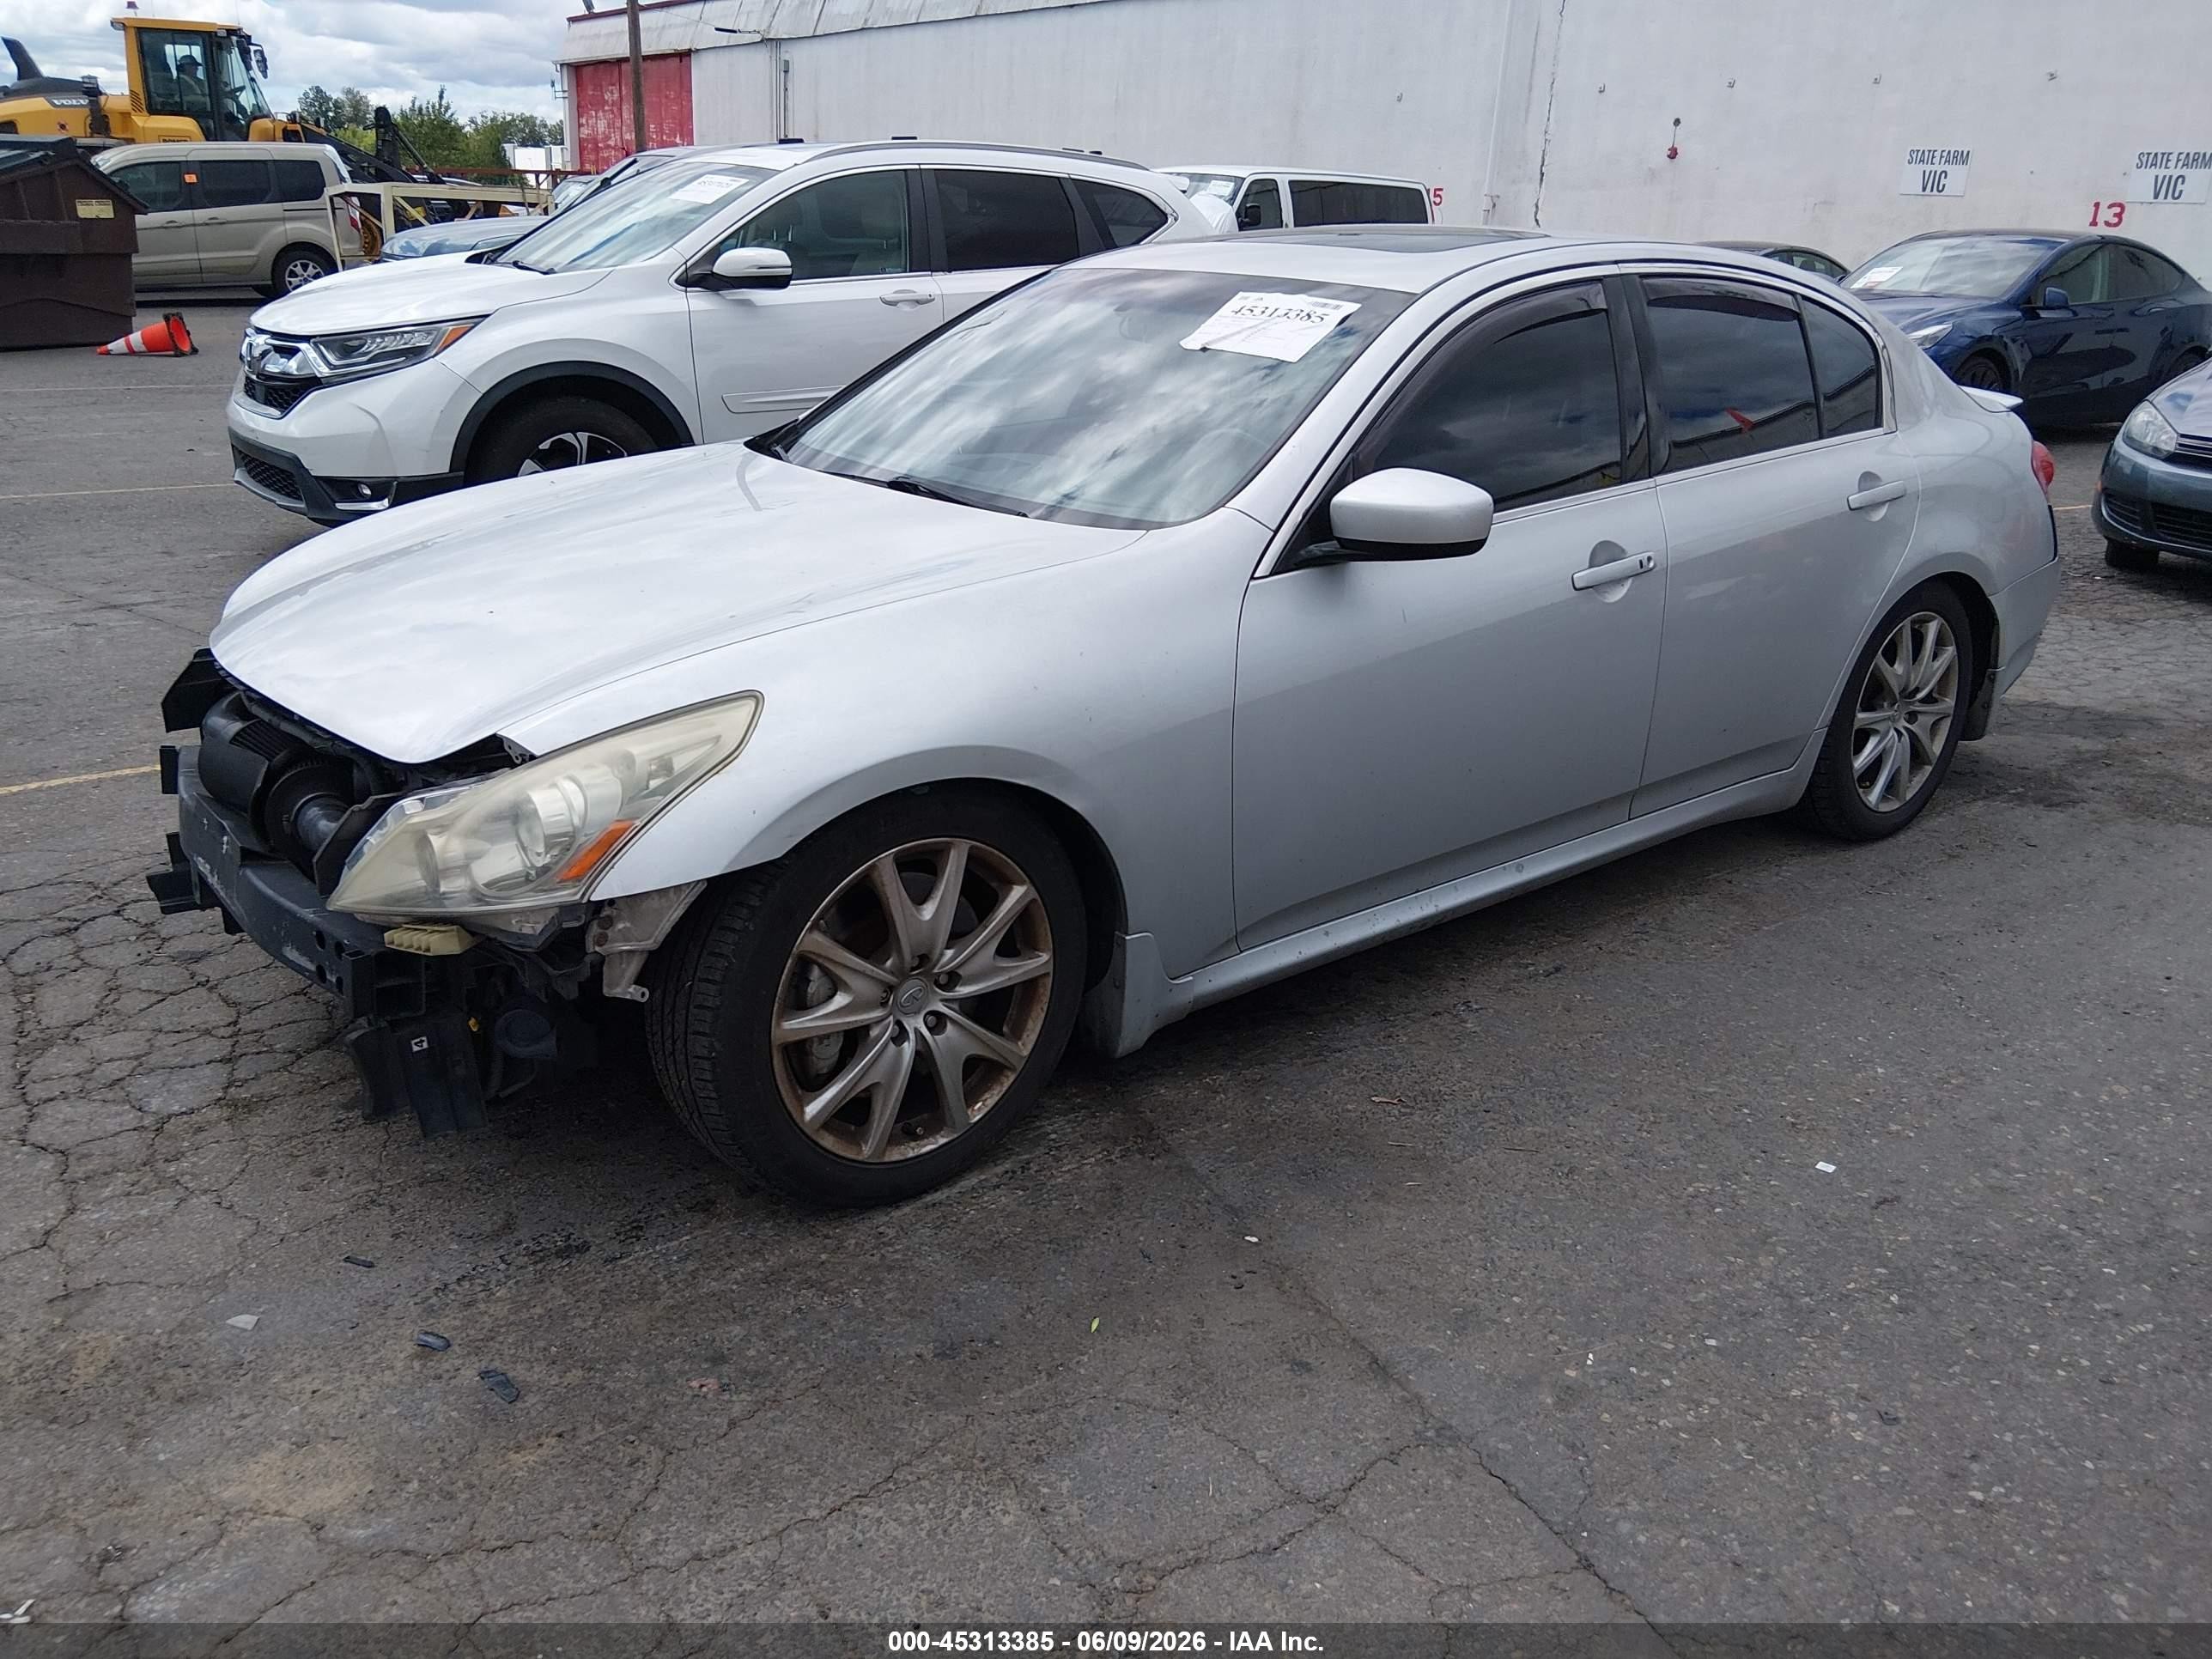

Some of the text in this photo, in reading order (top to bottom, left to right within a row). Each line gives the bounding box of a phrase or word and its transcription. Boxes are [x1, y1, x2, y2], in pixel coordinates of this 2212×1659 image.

[1907, 149, 1971, 166] STATE FARM
[2136, 151, 2212, 170] STATE FARM
[1922, 169, 1948, 193] VIC
[2153, 174, 2186, 201] VIC
[2088, 201, 2126, 228] 13
[1231, 304, 1330, 325] 45313385
